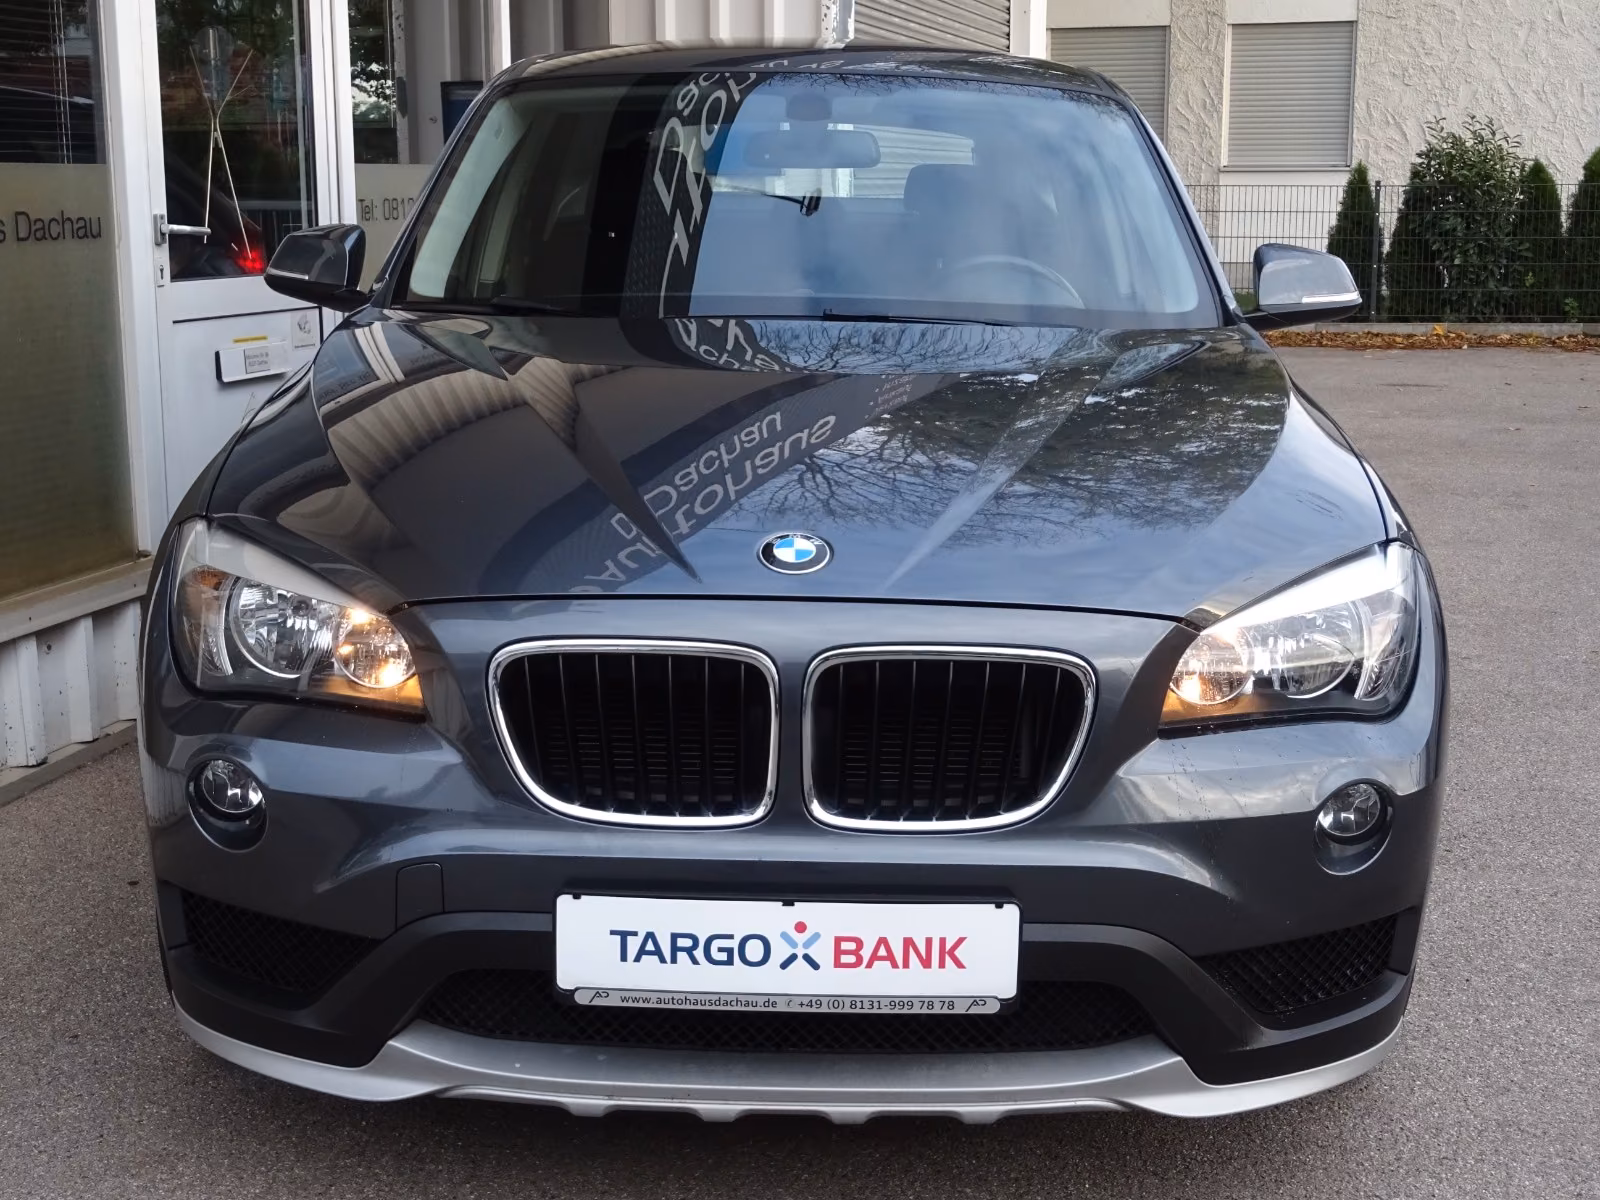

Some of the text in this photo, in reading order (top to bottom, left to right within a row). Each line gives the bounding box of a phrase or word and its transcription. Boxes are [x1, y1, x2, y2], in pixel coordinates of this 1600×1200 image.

[358, 198, 378, 221] Tel:
[15, 209, 102, 242] Dachau
[609, 929, 968, 969] TARGO BANK
[619, 994, 778, 1008] www.autohausdachau.de
[798, 998, 823, 1010] +49
[827, 999, 845, 1011] (0)
[849, 999, 914, 1011] 8131-999
[918, 1000, 935, 1011] 78
[939, 1000, 955, 1011] 78
